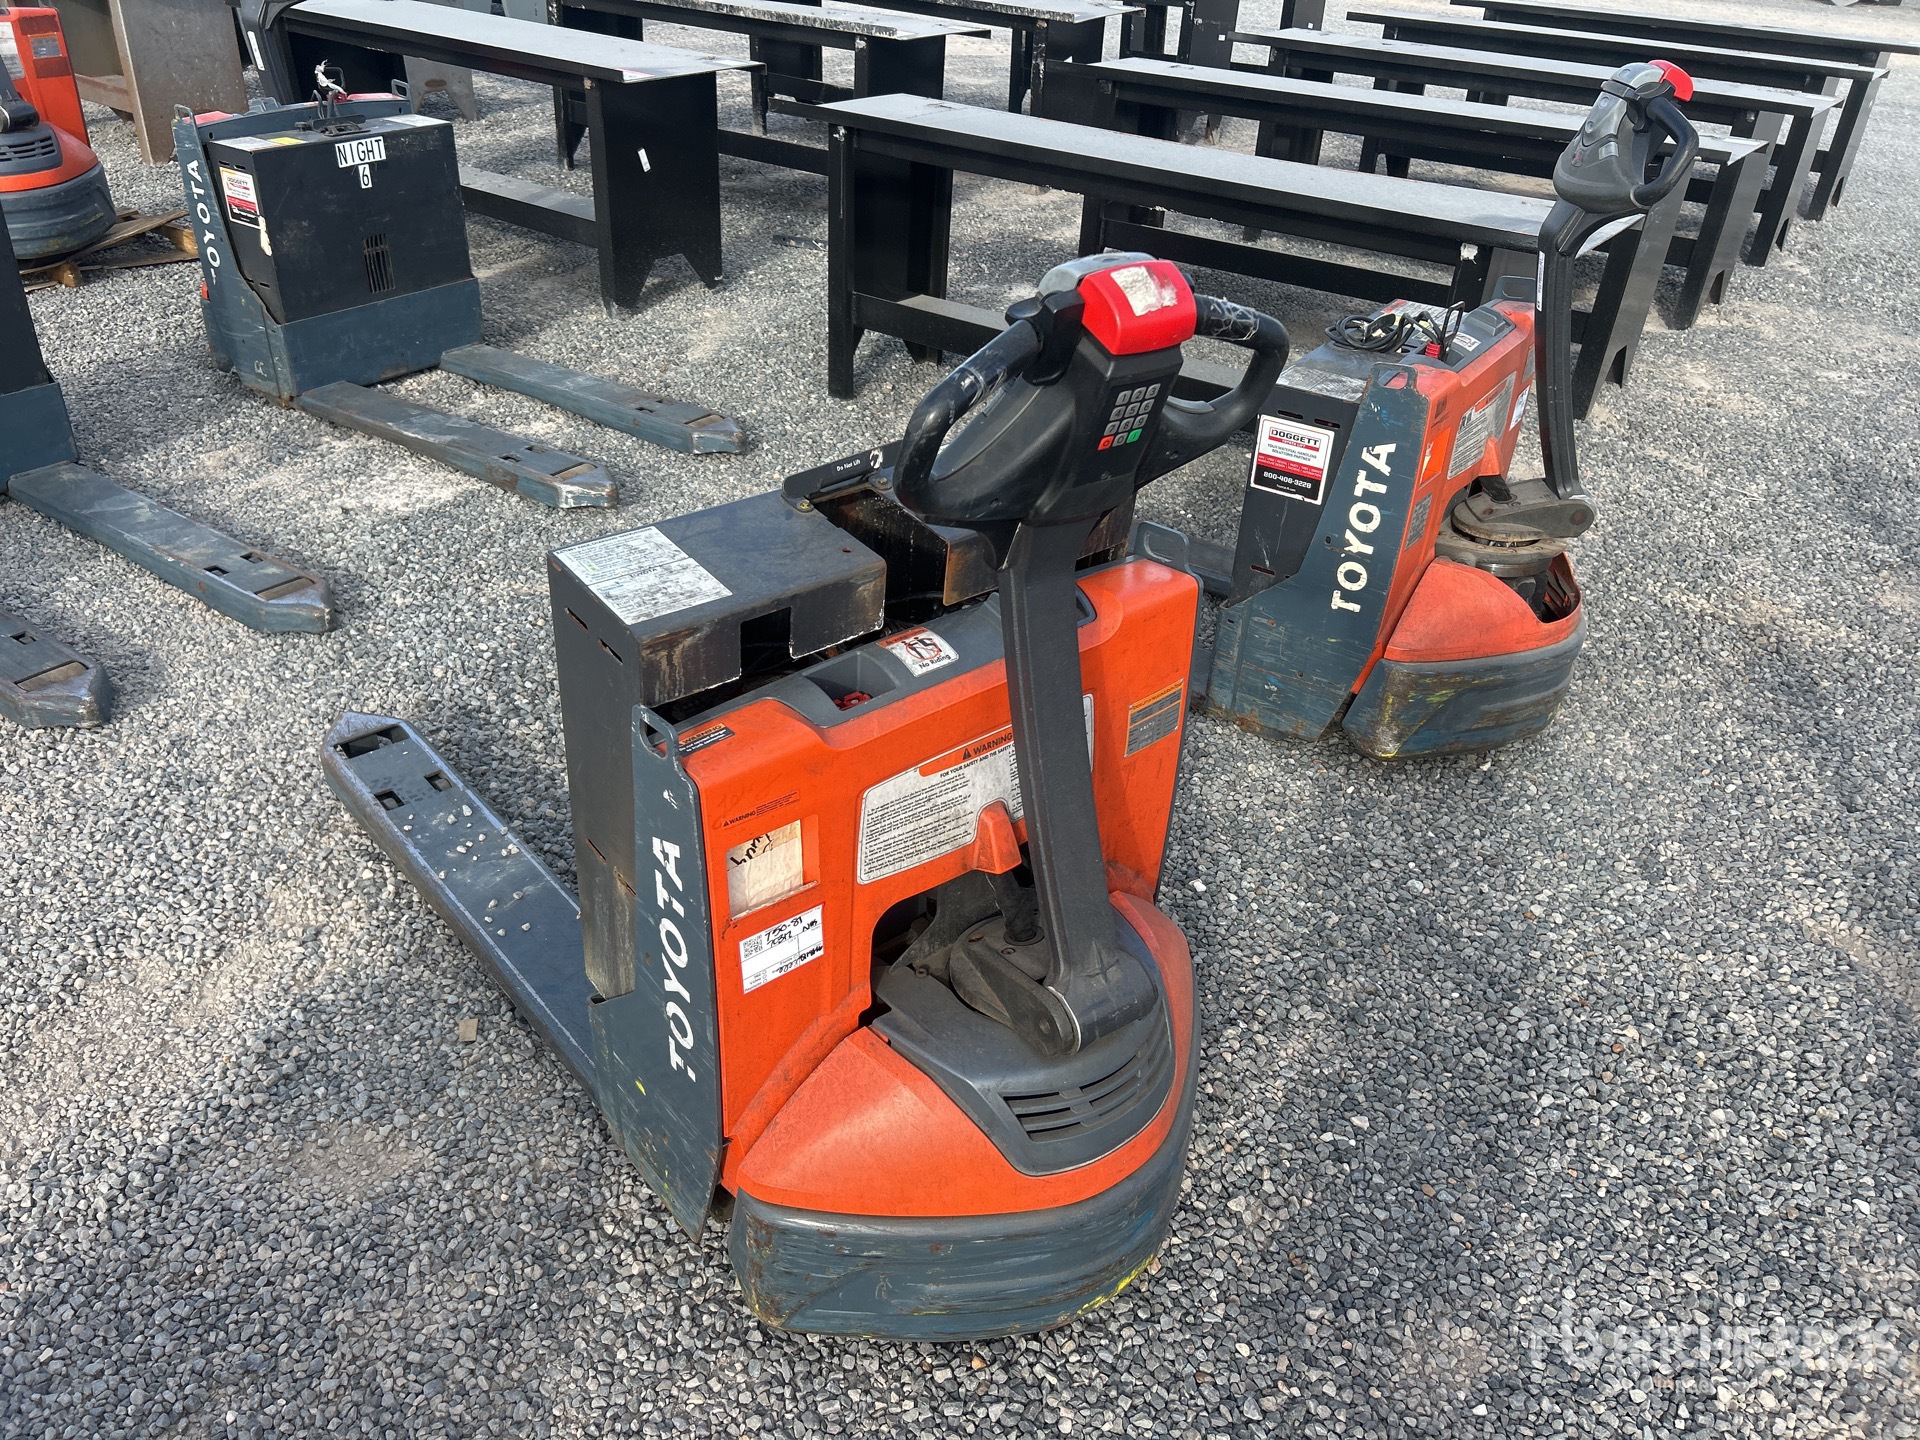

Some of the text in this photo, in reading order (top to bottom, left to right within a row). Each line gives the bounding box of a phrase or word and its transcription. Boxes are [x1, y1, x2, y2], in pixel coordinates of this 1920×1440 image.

[337, 138, 383, 165] NIGHT
[361, 166, 370, 187] 6
[1271, 429, 1319, 446] DOGGETT
[843, 461, 853, 469] Not
[1331, 443, 1396, 613] TOYOTA
[930, 654, 952, 665] Riding
[973, 732, 1013, 755] WARNING
[950, 765, 963, 774] YOUR
[963, 758, 979, 768] SAFETY
[979, 754, 990, 763] AND
[997, 744, 1012, 754] SAFETY
[729, 810, 757, 825] WARNING
[652, 836, 696, 1083] TOYOTA
